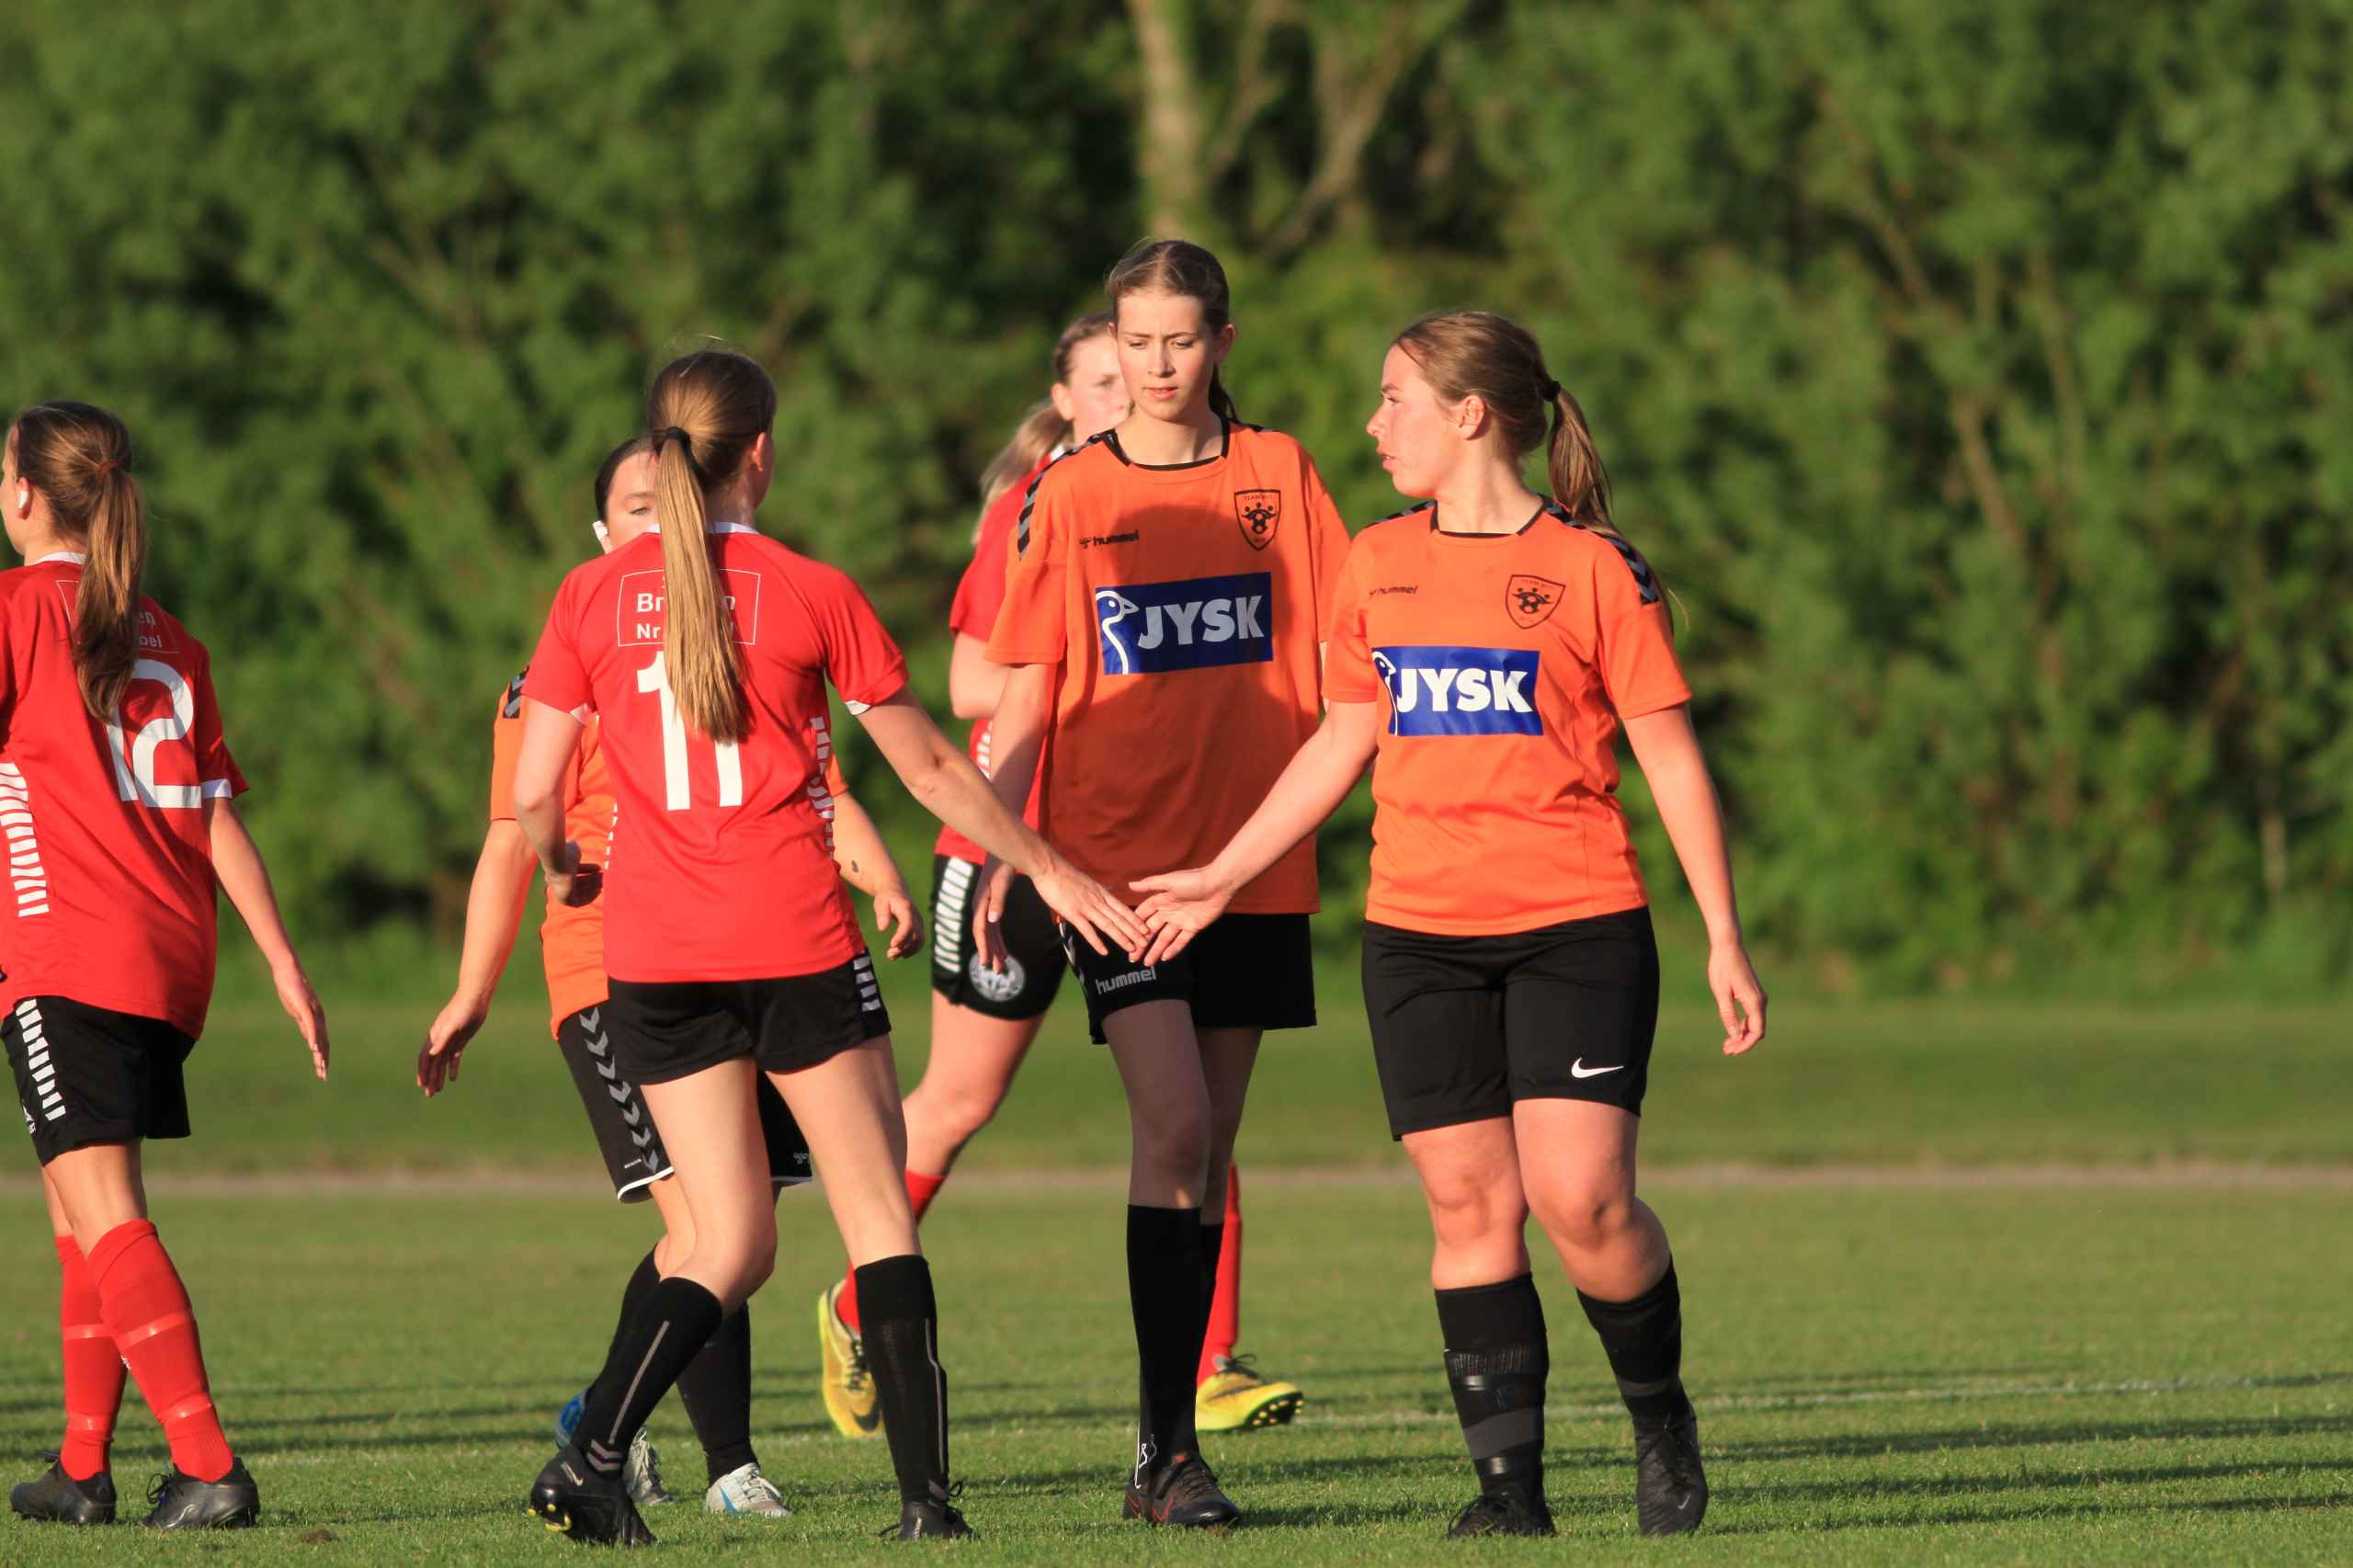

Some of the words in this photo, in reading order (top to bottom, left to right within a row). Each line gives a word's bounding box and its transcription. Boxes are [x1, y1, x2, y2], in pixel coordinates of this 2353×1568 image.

[1137, 595, 1265, 650] JYSK
[1396, 668, 1533, 713] JYSK
[1096, 965, 1156, 994] hummel
